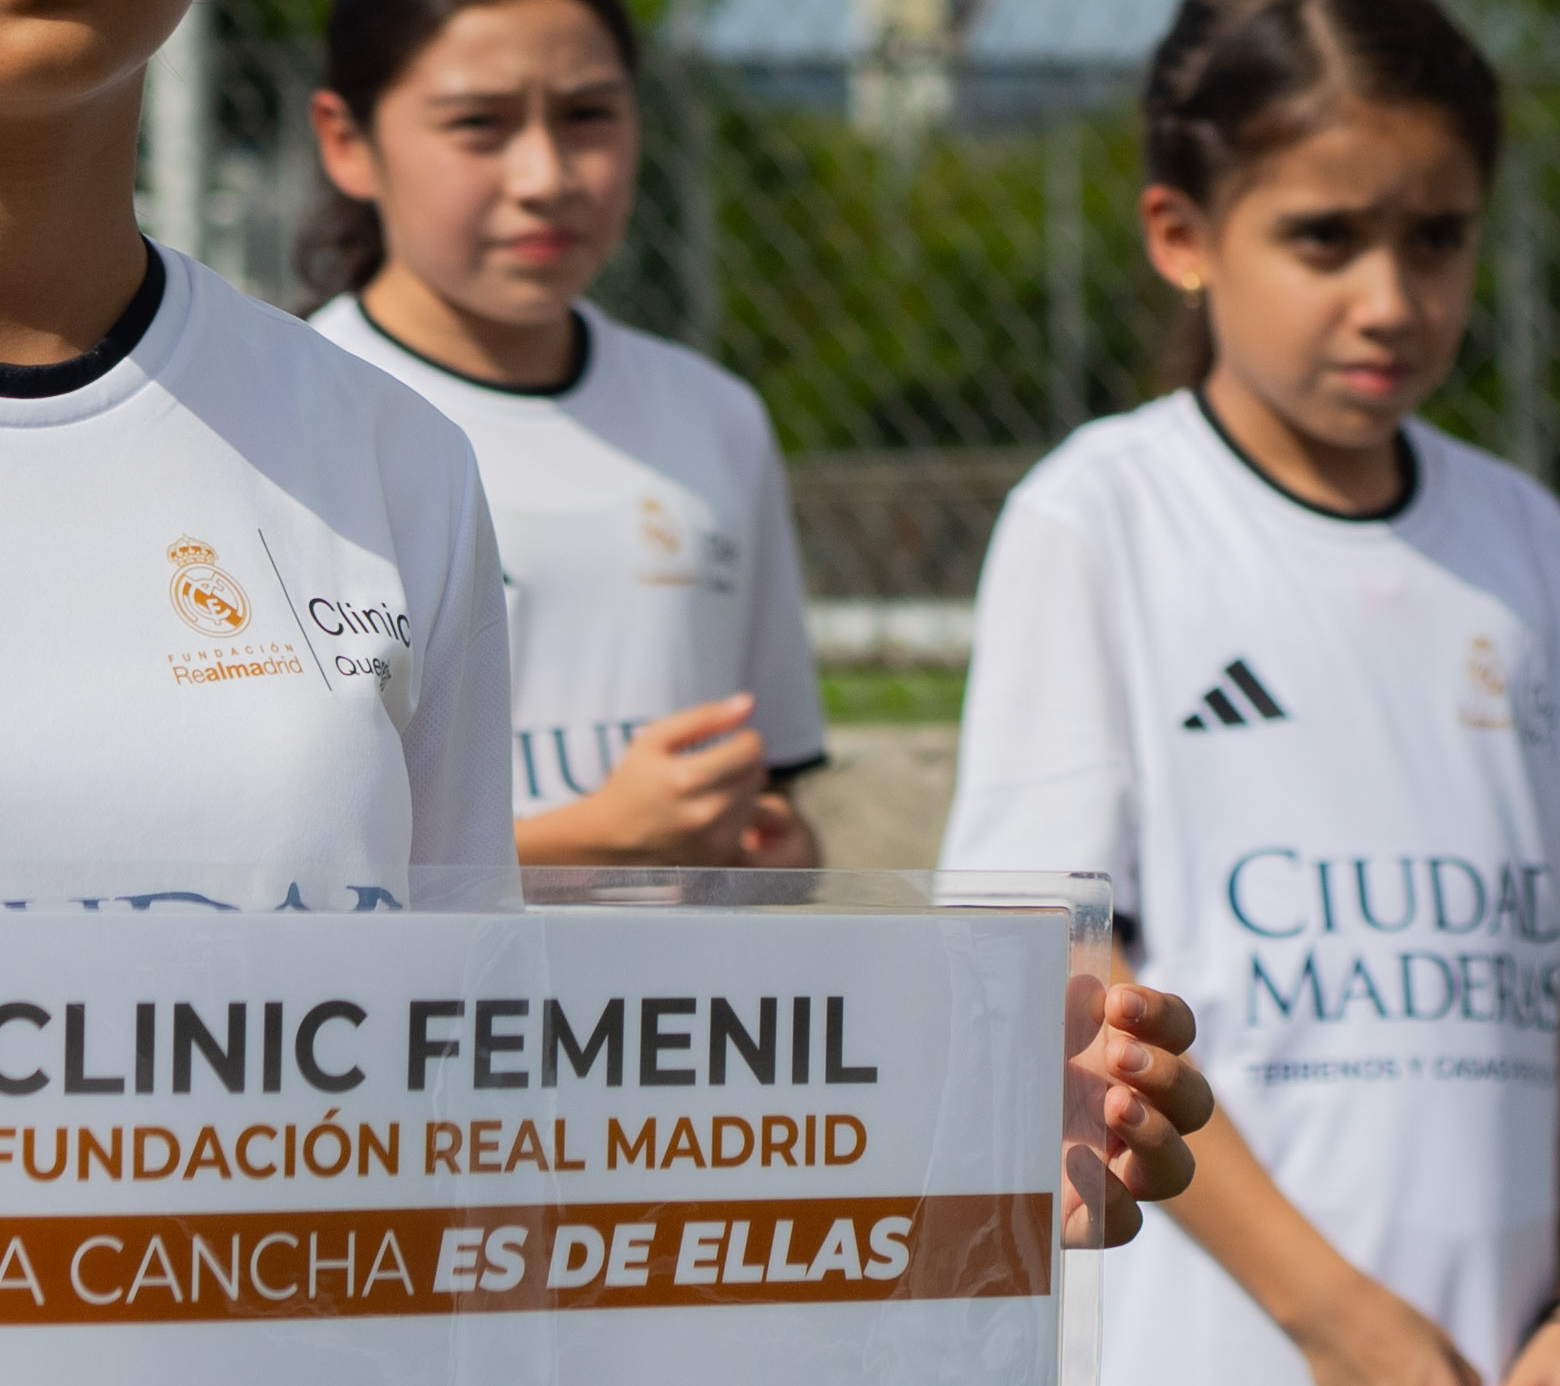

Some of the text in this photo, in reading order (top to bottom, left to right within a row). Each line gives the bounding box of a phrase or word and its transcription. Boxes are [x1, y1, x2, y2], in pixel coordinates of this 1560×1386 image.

[167, 642, 295, 663] FUNDACIÓN
[172, 656, 303, 686] Realmadrid
[407, 996, 878, 1091] FEMENIL
[425, 1117, 586, 1176] REAL
[606, 1115, 868, 1170] MADRID
[70, 1230, 415, 1306] CANCHA
[432, 1225, 530, 1294] ES
[546, 1222, 657, 1289] DE
[673, 1216, 915, 1285] ELLAS
